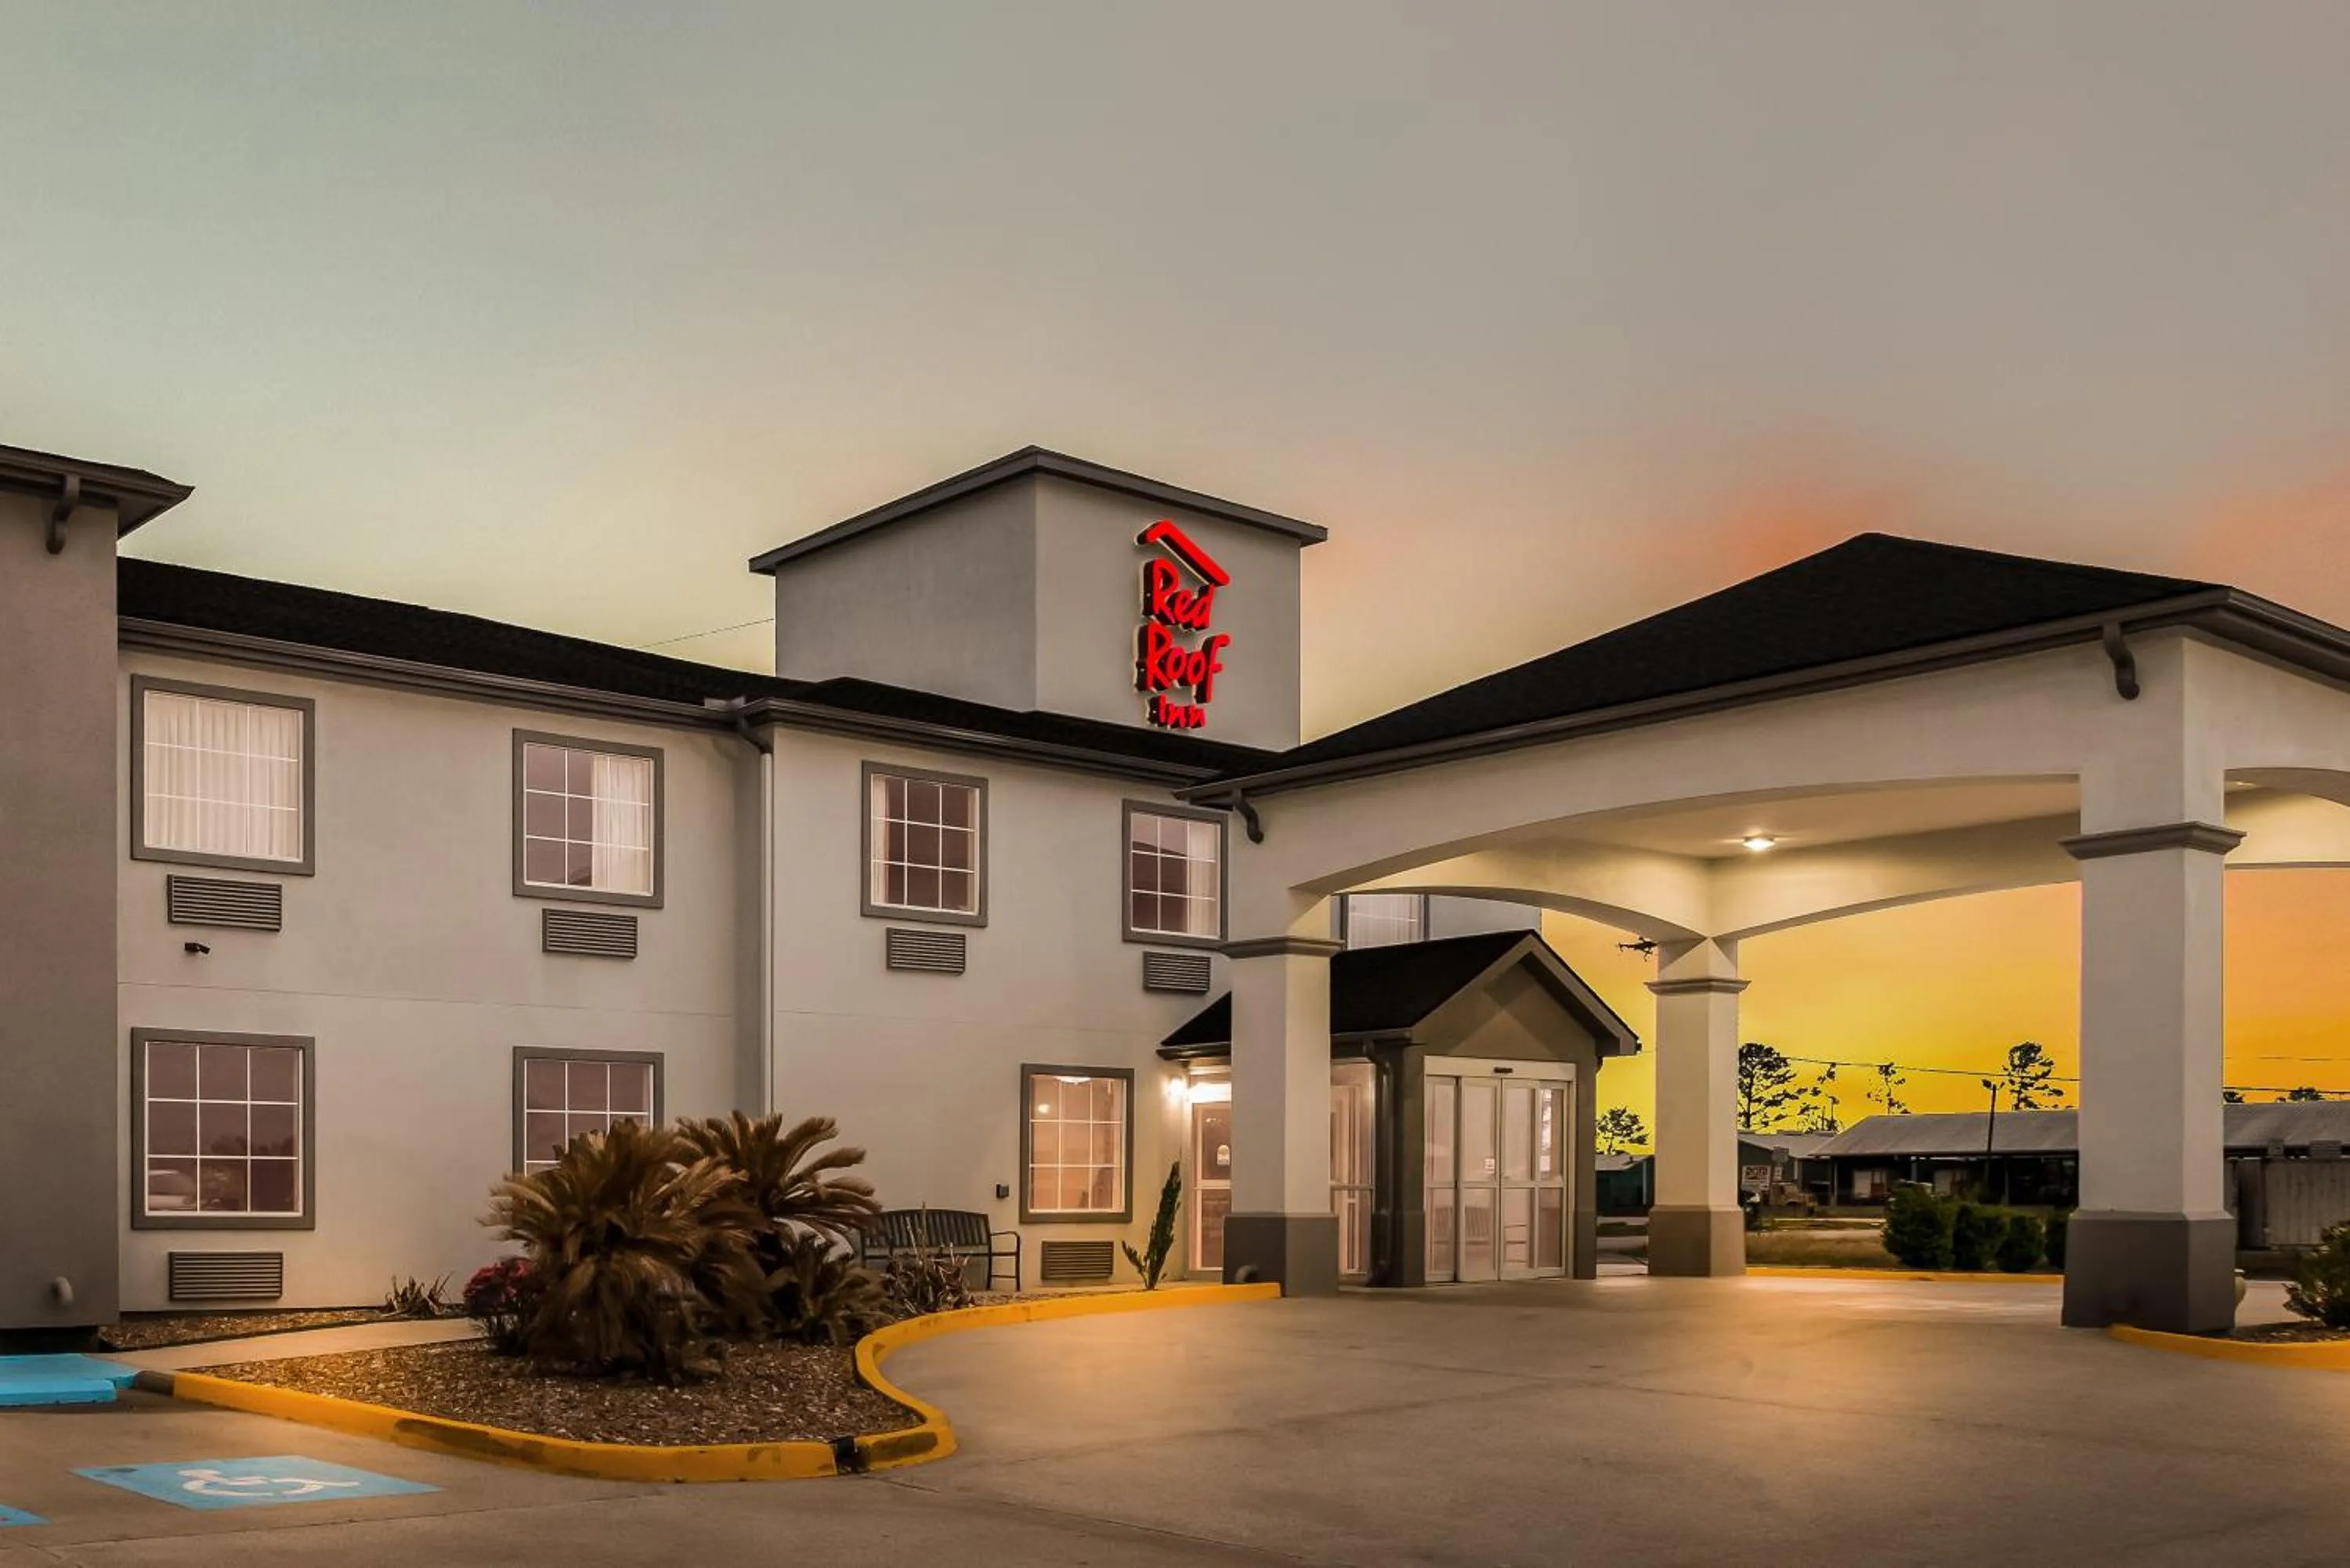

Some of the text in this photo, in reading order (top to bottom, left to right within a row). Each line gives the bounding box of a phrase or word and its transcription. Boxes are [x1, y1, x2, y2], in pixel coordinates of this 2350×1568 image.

[1150, 557, 1215, 628] Red
[1144, 621, 1231, 703] Roof
[1157, 695, 1206, 728] Inn
